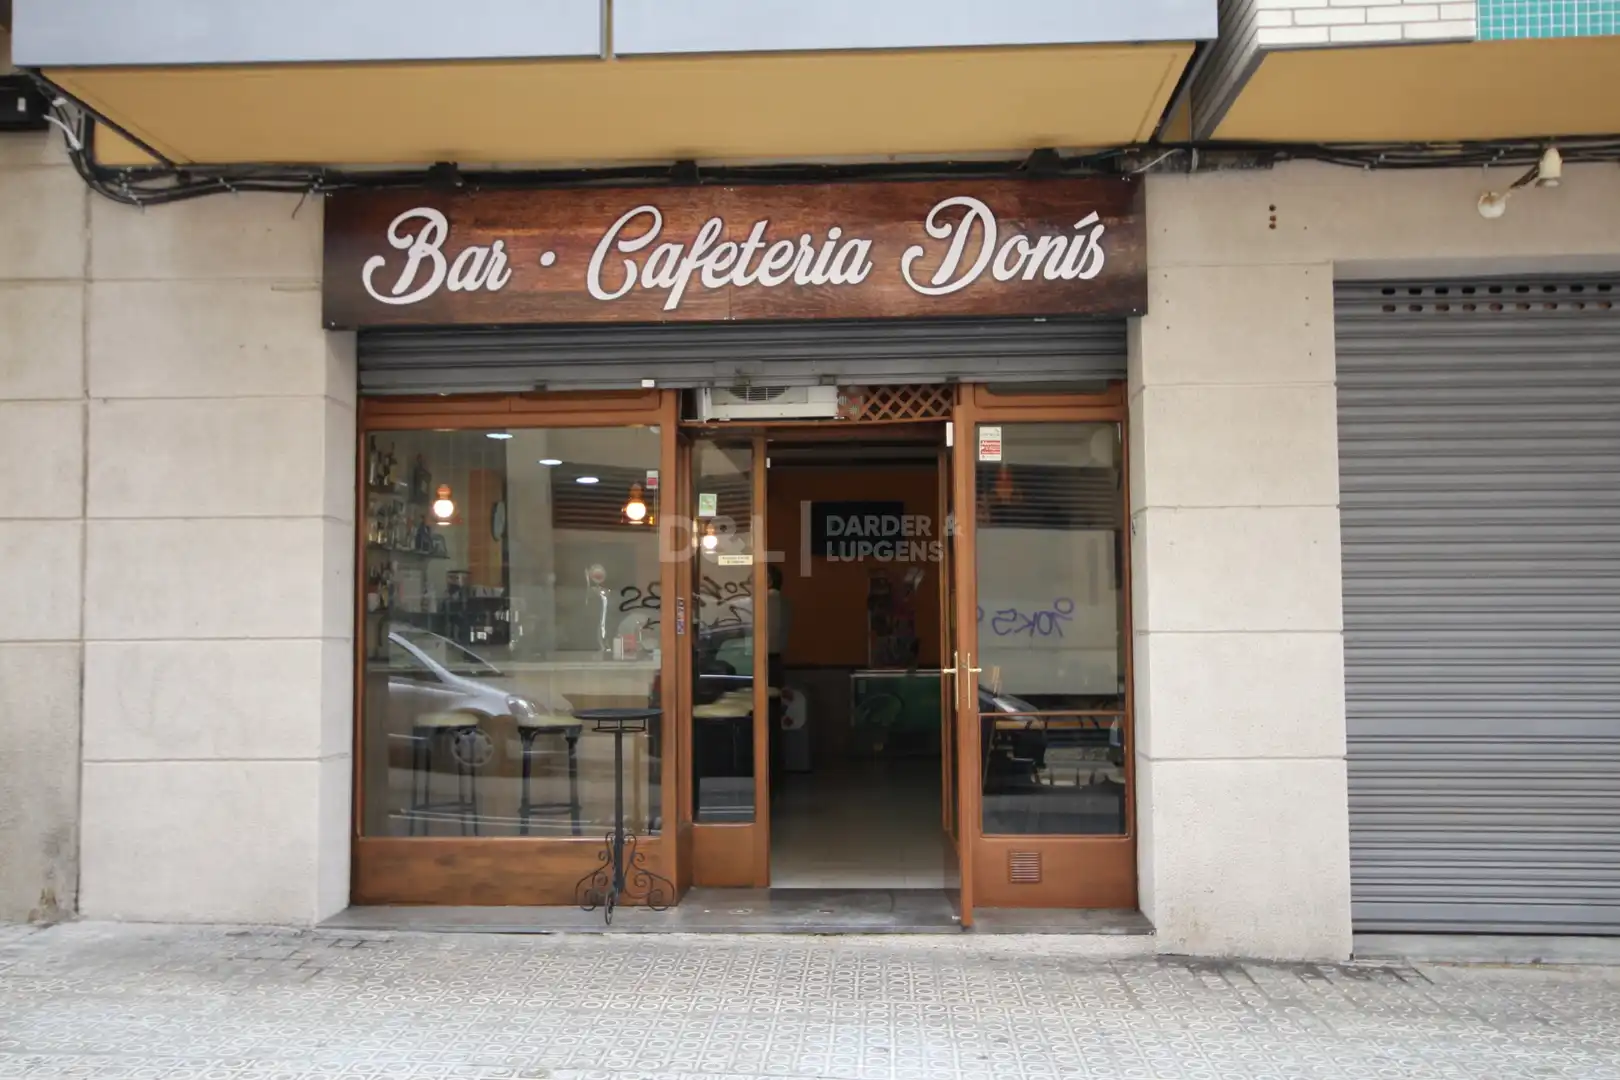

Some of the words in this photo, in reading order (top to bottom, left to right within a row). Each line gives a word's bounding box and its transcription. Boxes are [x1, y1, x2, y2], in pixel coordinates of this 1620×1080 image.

[362, 207, 513, 305] Bar
[586, 205, 873, 311] Cafeteria
[901, 196, 1105, 296] Donís
